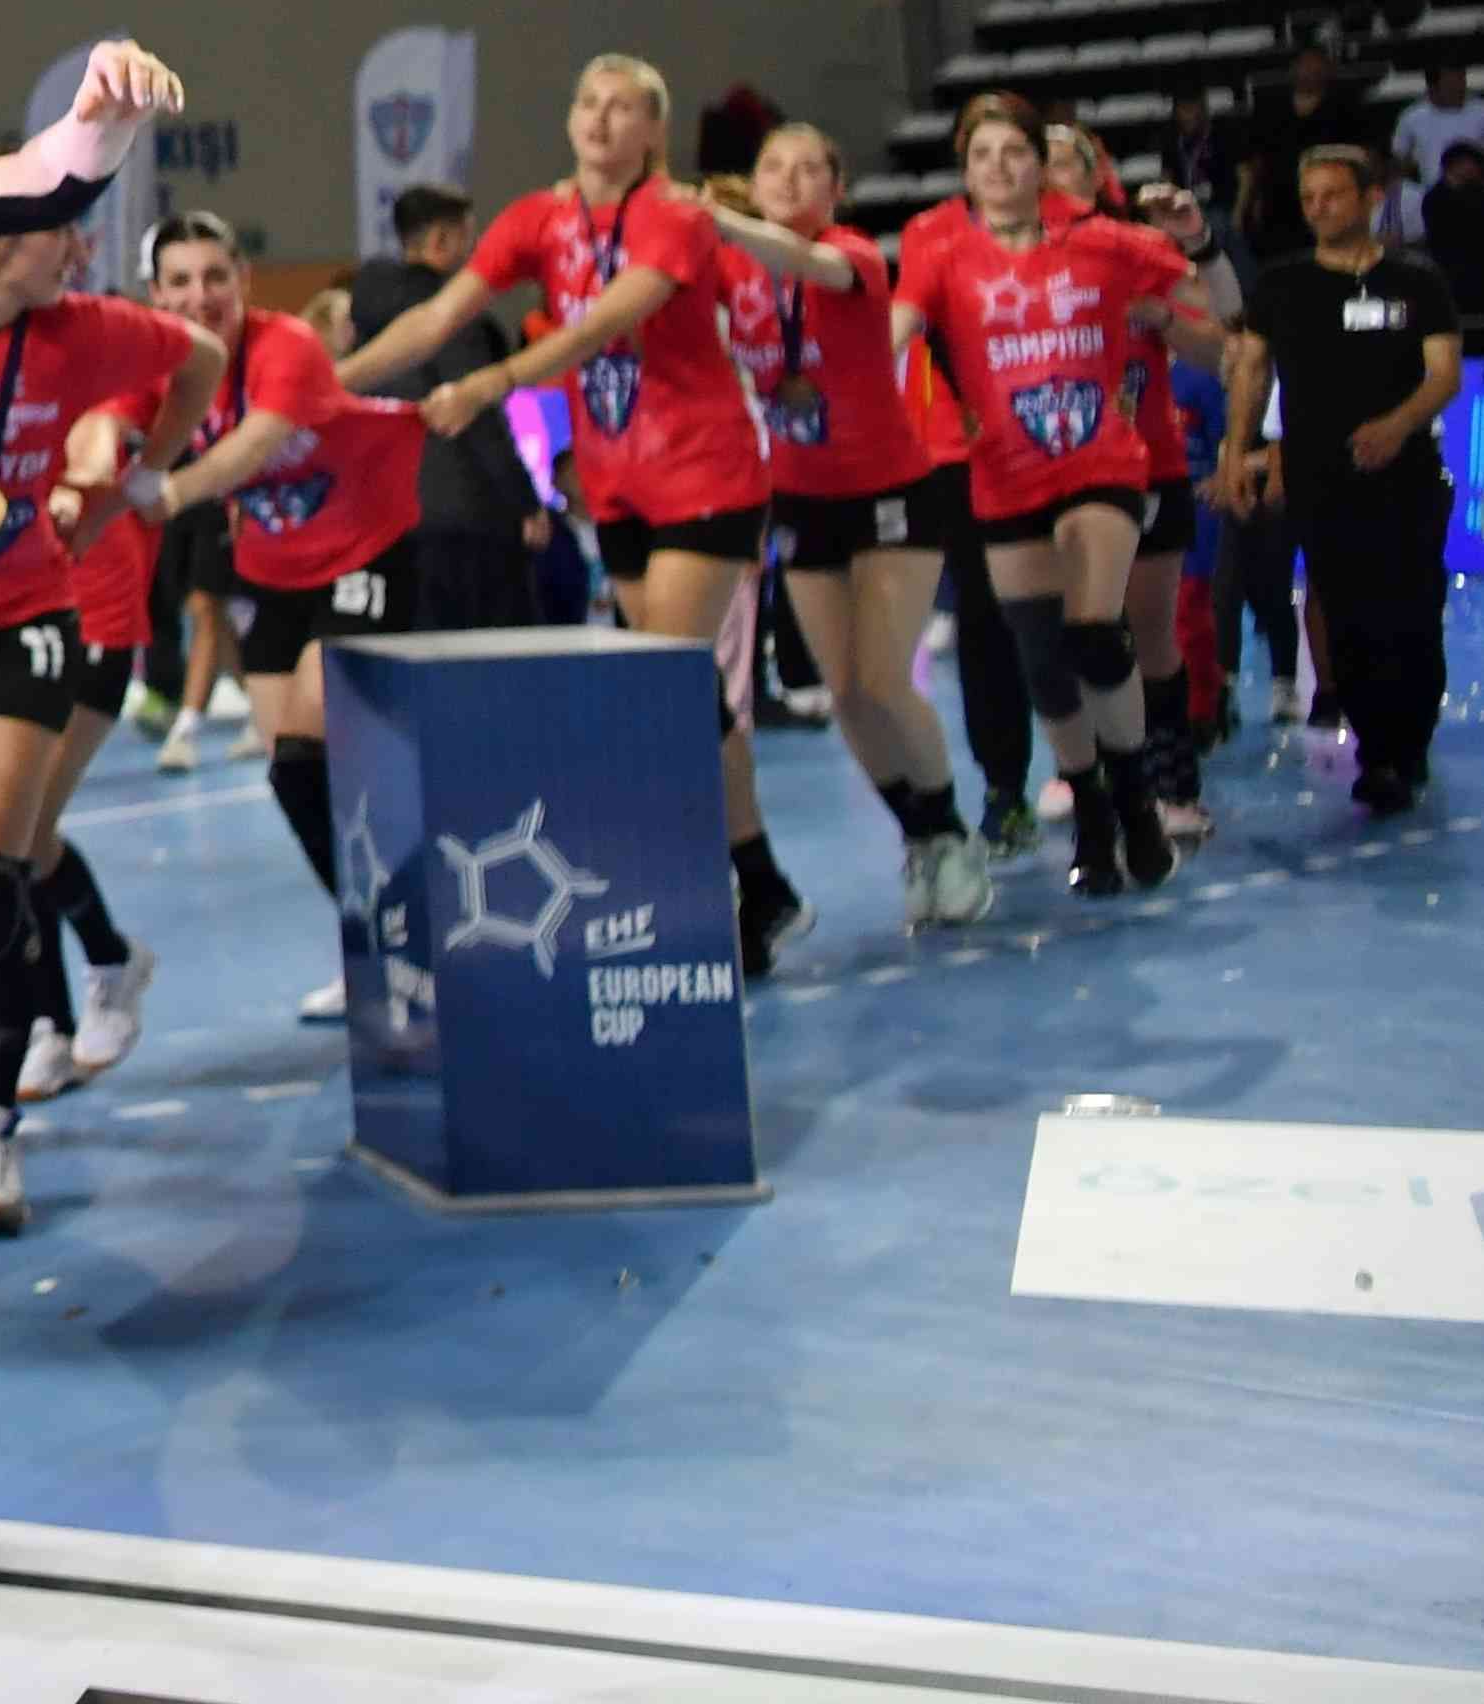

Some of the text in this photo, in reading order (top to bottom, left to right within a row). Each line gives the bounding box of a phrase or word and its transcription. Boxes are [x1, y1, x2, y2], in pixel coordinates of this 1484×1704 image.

[585, 902, 656, 950] EHF
[588, 962, 733, 1006] EUROPEAN
[591, 1005, 645, 1046] CUP
